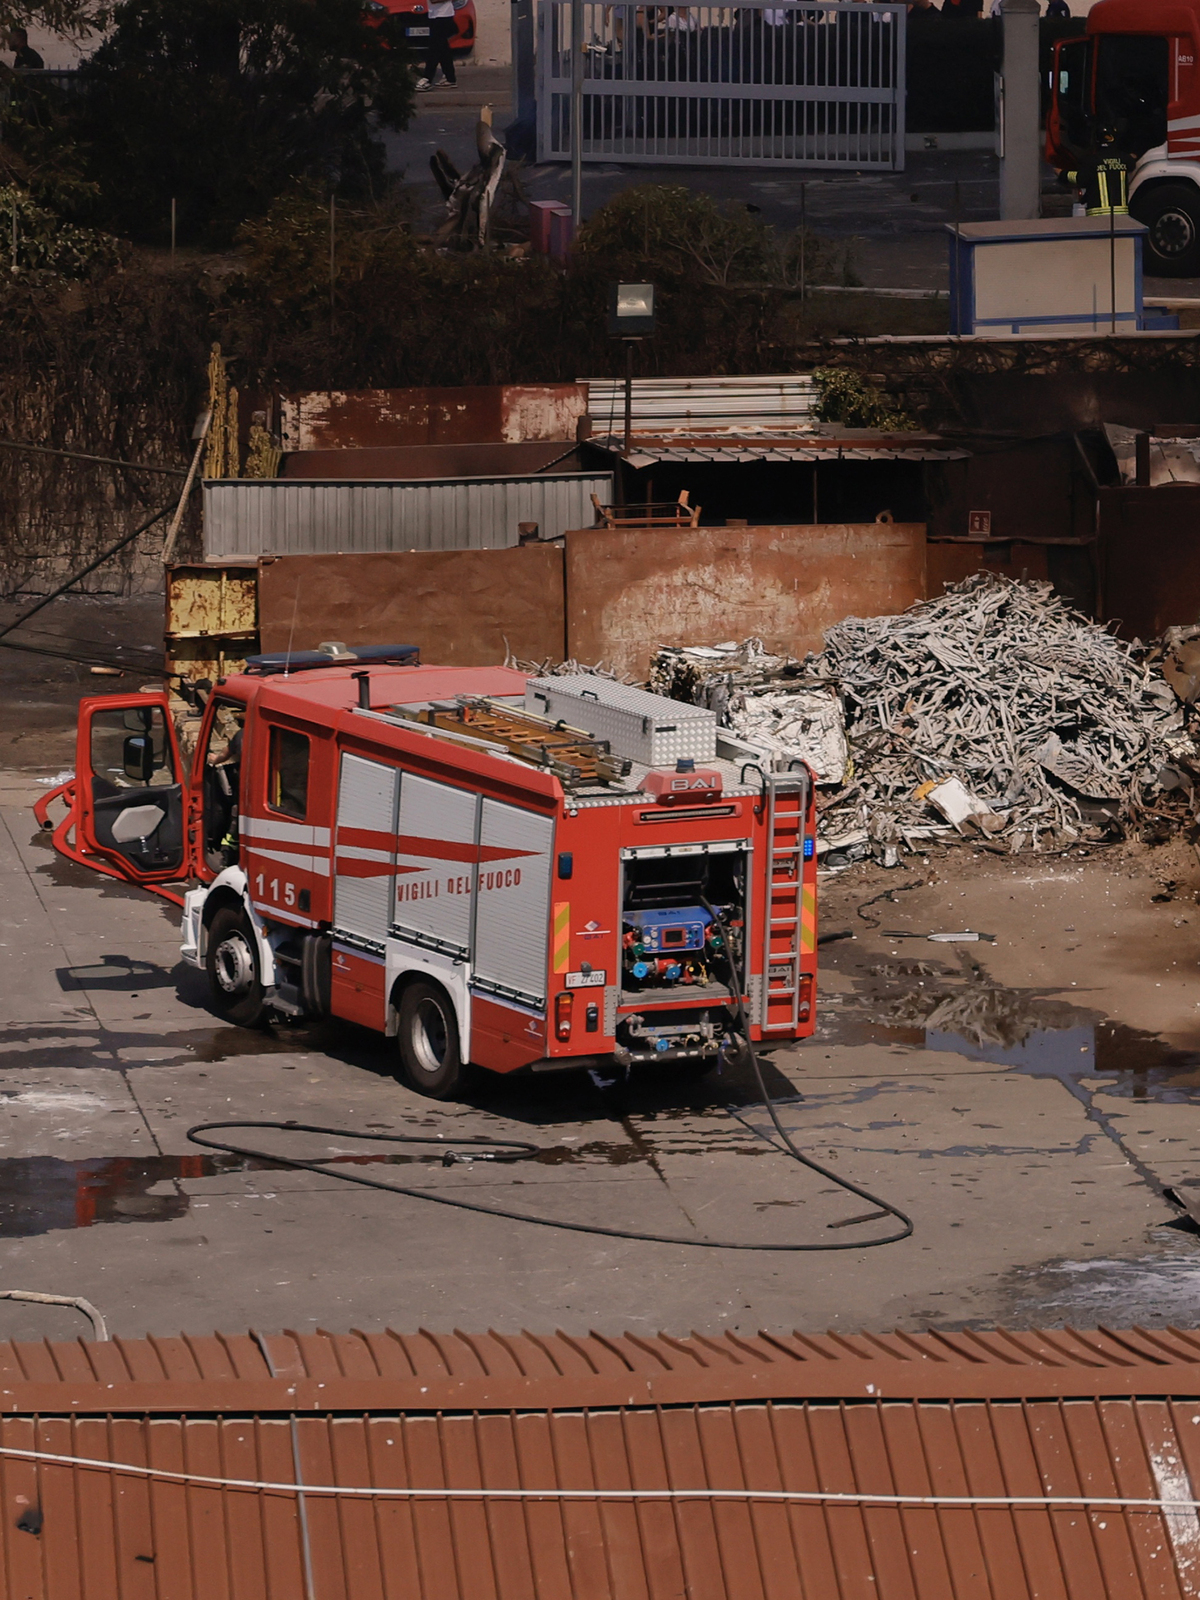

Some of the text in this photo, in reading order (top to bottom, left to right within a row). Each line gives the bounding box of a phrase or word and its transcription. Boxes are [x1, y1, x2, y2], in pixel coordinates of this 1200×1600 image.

[671, 777, 716, 791] BAI
[255, 873, 296, 906] 115
[397, 868, 522, 902] VIGILI DEL FUOCO
